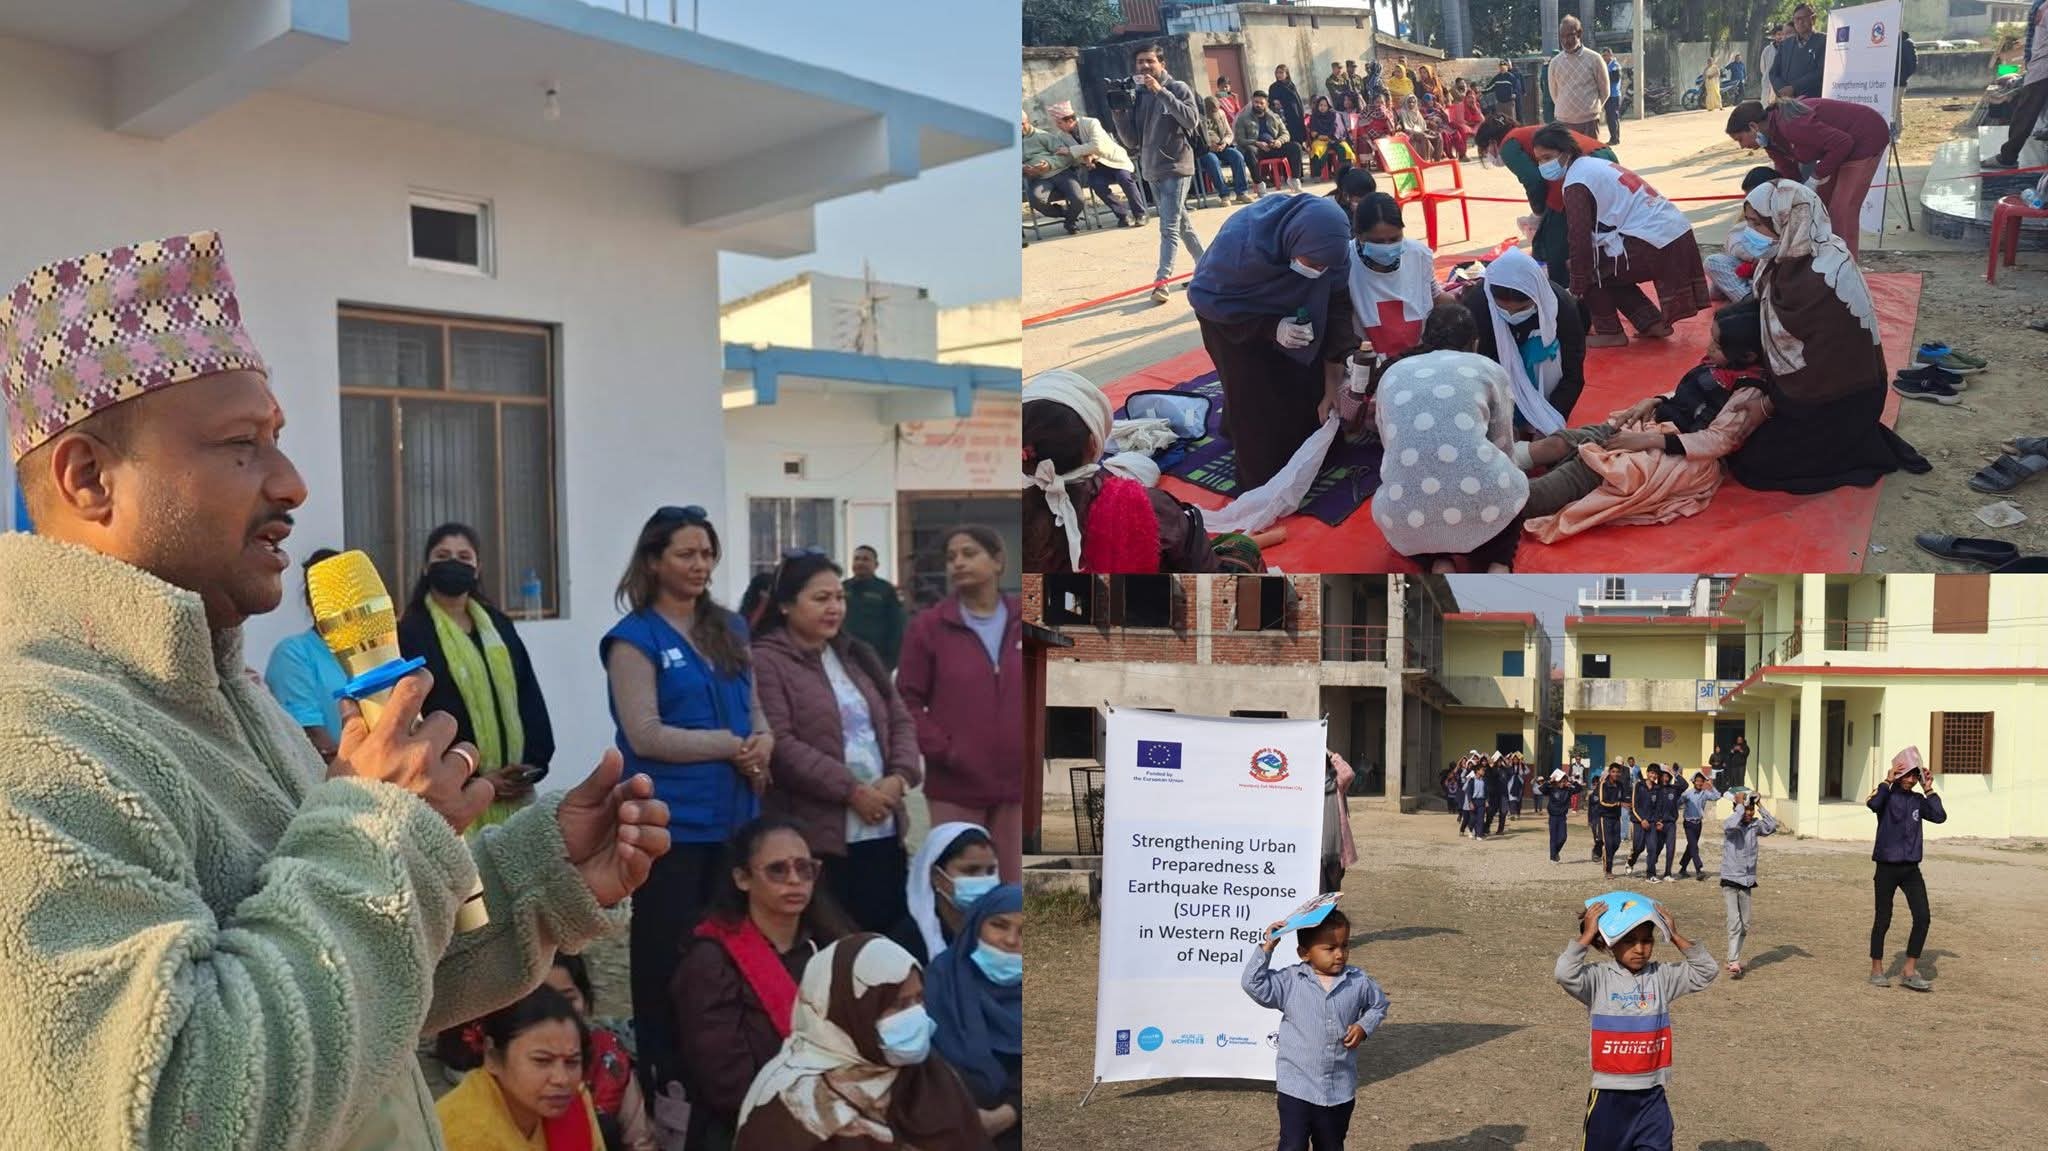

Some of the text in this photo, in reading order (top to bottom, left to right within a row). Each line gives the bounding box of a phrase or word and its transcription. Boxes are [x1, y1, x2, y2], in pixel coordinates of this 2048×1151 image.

[1869, 80, 1887, 89] Urban
[1132, 833, 1296, 855] Strengthening Urban
[1152, 857, 1276, 875] Preparedness &
[1128, 880, 1297, 899] Earthquake Response
[1174, 902, 1251, 921] (SUPER II)
[1139, 925, 1268, 944] in Western Regi
[1177, 948, 1243, 965] of Nepal
